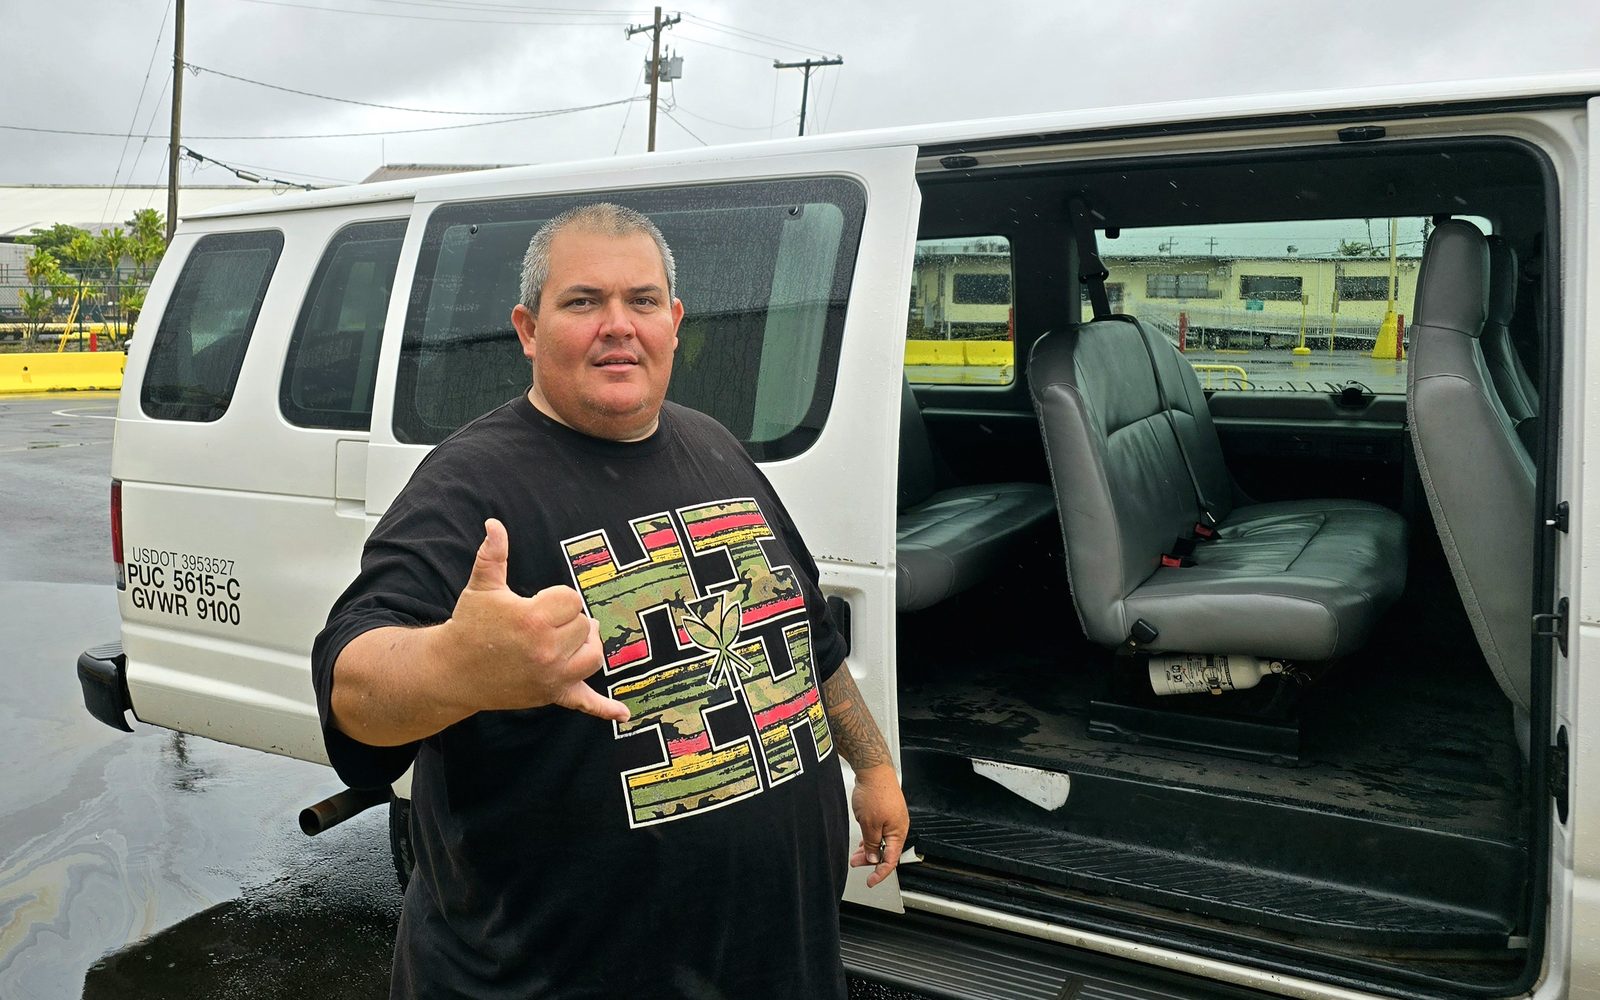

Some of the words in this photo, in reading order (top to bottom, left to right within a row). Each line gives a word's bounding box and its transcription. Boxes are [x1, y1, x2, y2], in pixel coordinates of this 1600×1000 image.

[132, 546, 178, 568] USDOT
[181, 554, 235, 576] 3953527
[127, 563, 165, 588] PUC
[173, 570, 241, 601] 5615-C
[132, 587, 189, 617] GVWR
[196, 597, 241, 626] 9100
